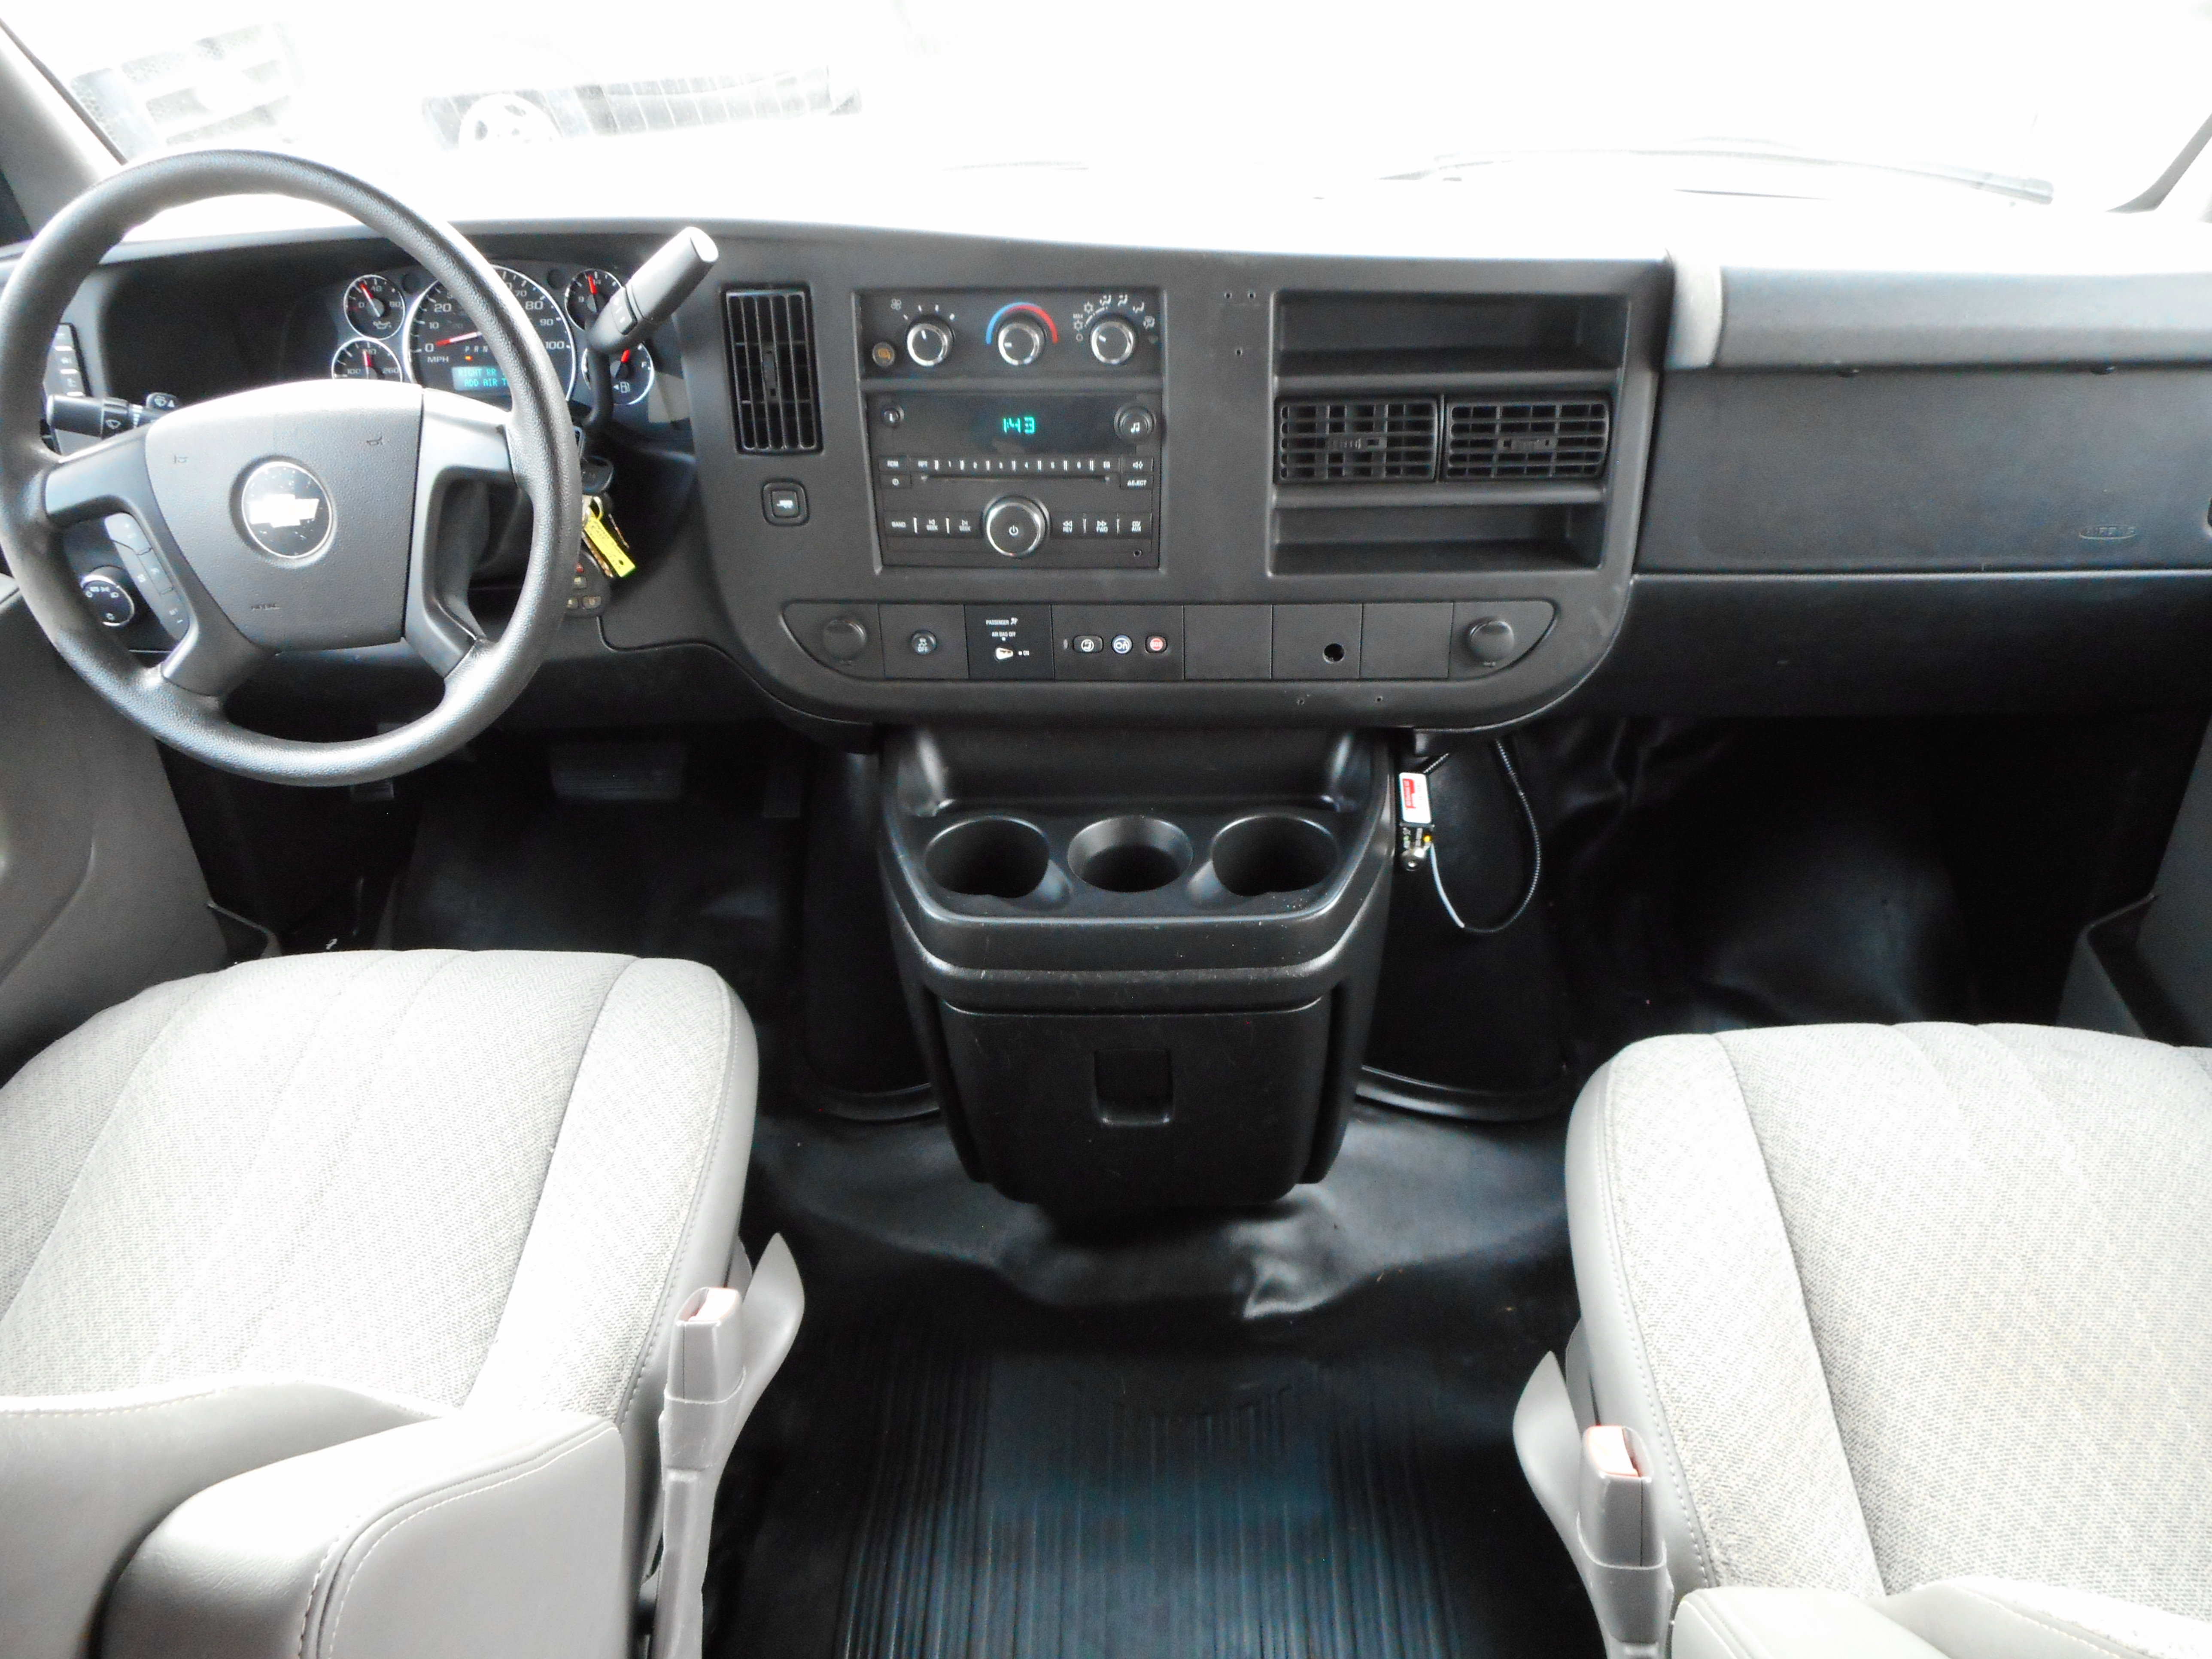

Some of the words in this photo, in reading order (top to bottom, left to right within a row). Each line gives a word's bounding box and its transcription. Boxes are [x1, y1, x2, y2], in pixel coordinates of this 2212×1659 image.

[434, 303, 451, 312] 20
[525, 301, 543, 310] 80
[425, 343, 434, 352] 0
[545, 340, 565, 349] 100
[458, 368, 482, 377] RIGHT
[464, 378, 479, 386] ADD
[483, 378, 498, 386] AIR
